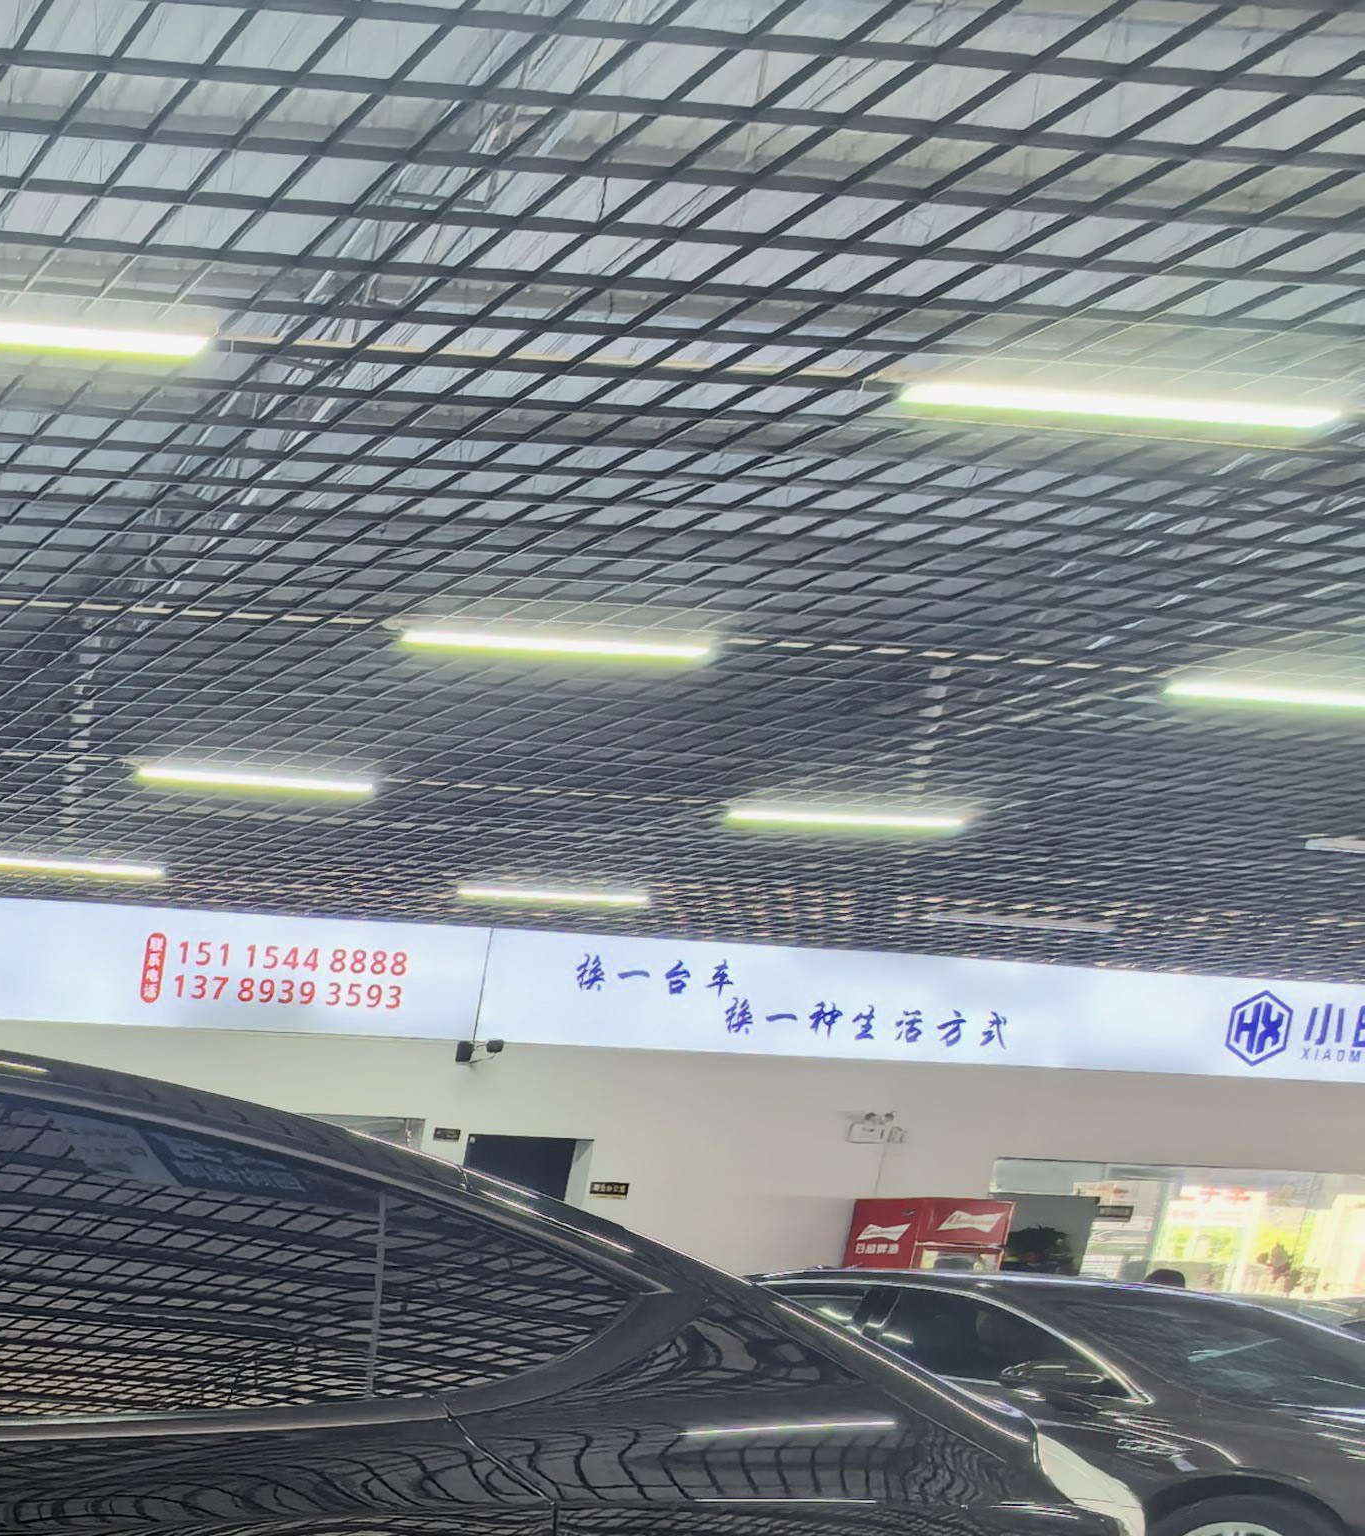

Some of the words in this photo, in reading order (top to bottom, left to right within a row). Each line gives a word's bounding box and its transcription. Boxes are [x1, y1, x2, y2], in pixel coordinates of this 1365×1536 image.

[178, 940, 230, 968] 151
[246, 944, 320, 972] 1544
[329, 949, 408, 977] 8888
[575, 953, 736, 998] 换一台车
[173, 974, 230, 1001] 137
[237, 977, 317, 1006] 8939
[325, 981, 403, 1010] 3593
[724, 996, 1008, 1050] 换一种生活方式
